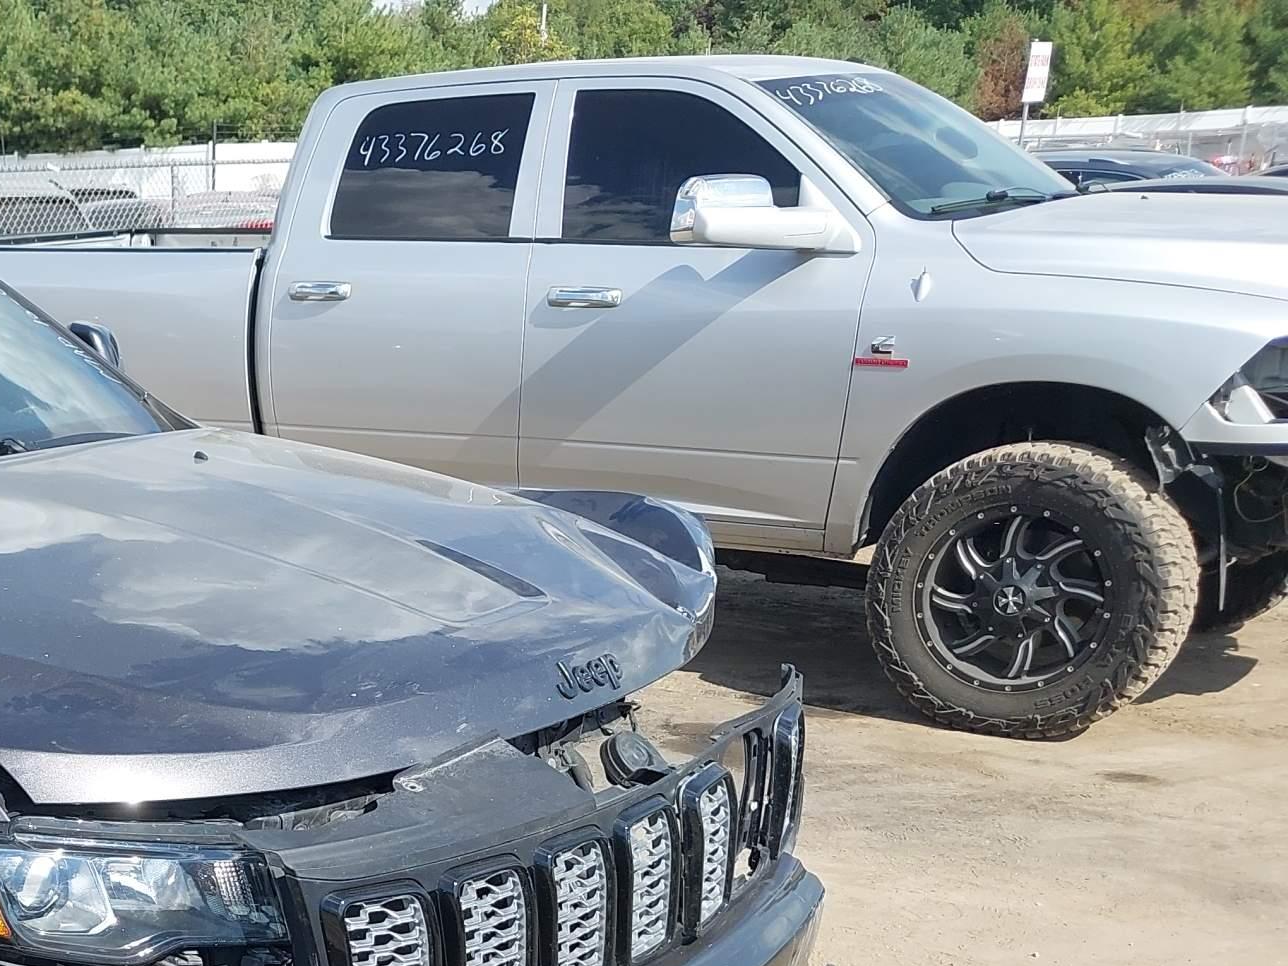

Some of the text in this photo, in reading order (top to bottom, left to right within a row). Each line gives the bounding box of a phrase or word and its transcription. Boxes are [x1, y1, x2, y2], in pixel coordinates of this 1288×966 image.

[775, 76, 884, 106] 43376268
[359, 128, 510, 167] 43376268
[555, 653, 624, 700] Jeep
